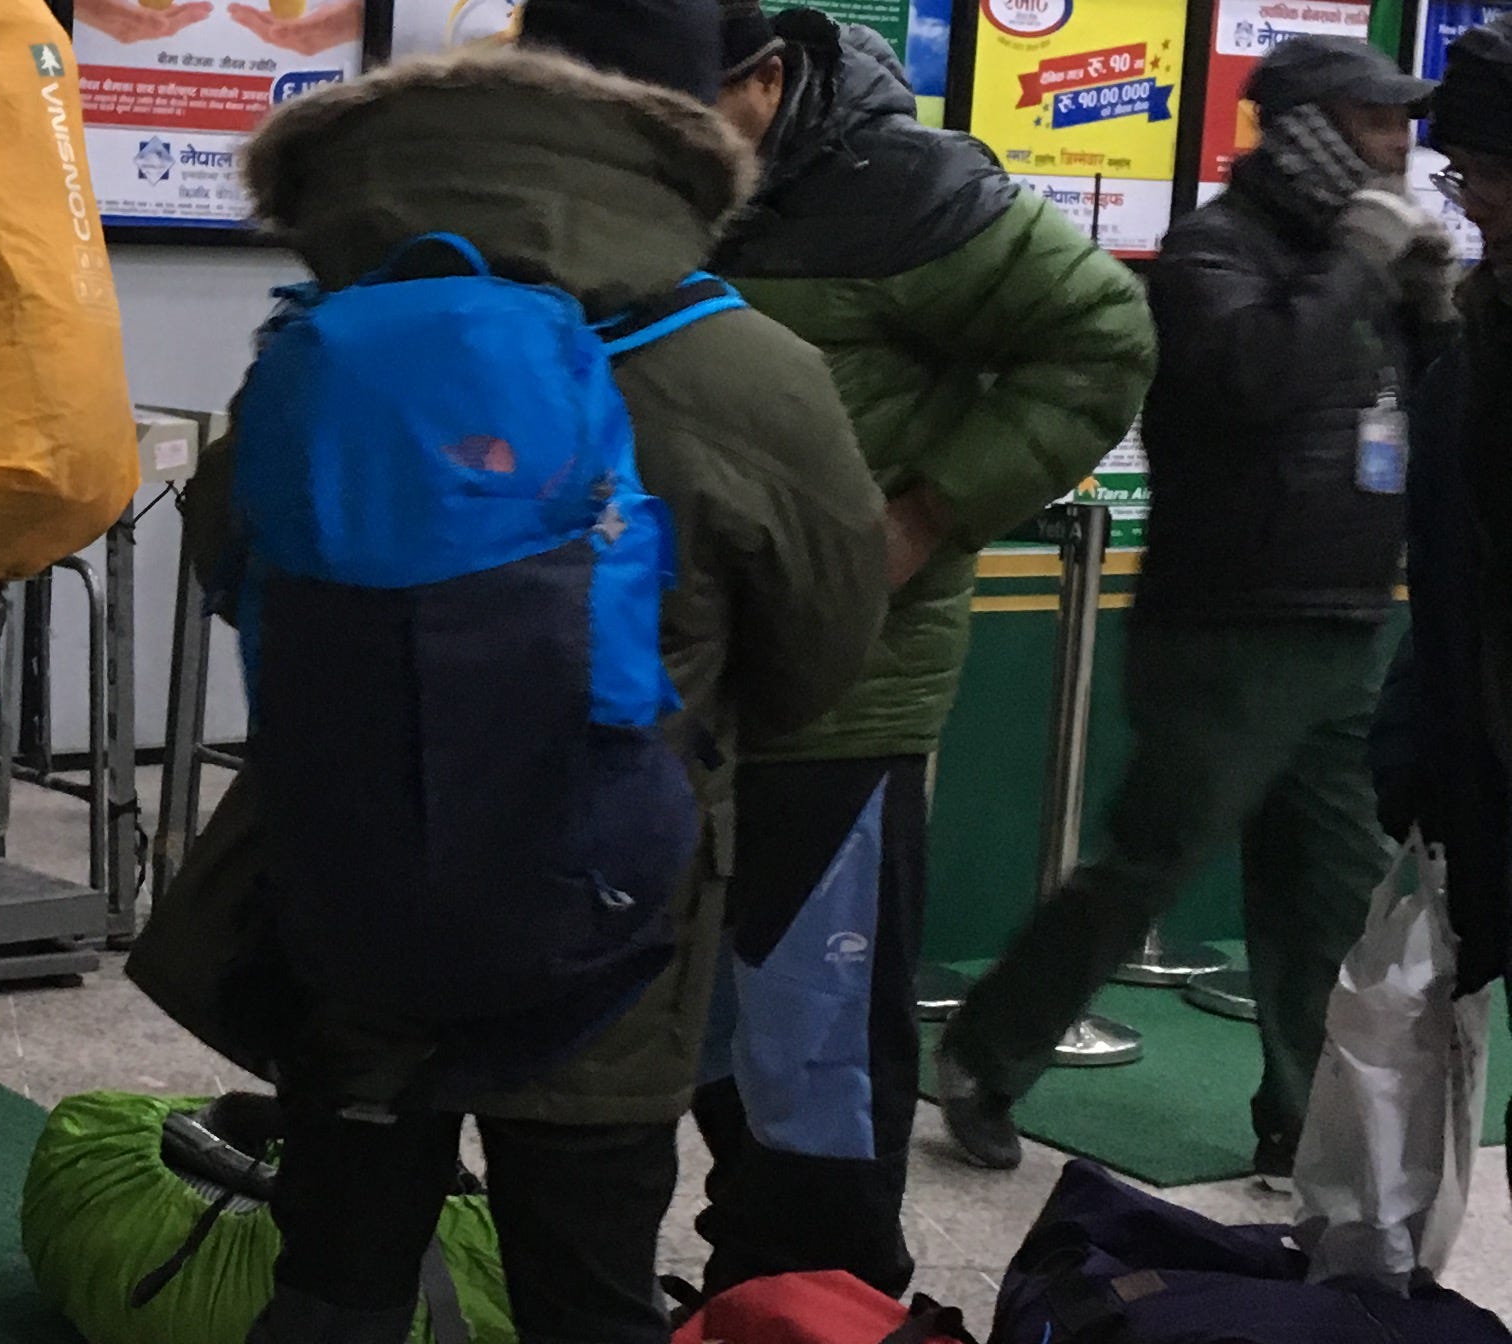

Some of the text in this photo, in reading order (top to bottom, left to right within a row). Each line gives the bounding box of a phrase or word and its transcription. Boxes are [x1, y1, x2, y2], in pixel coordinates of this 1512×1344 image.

[1110, 53, 1130, 72] १०
[180, 144, 232, 168] नेपाल
[1097, 487, 1129, 500] Tara
